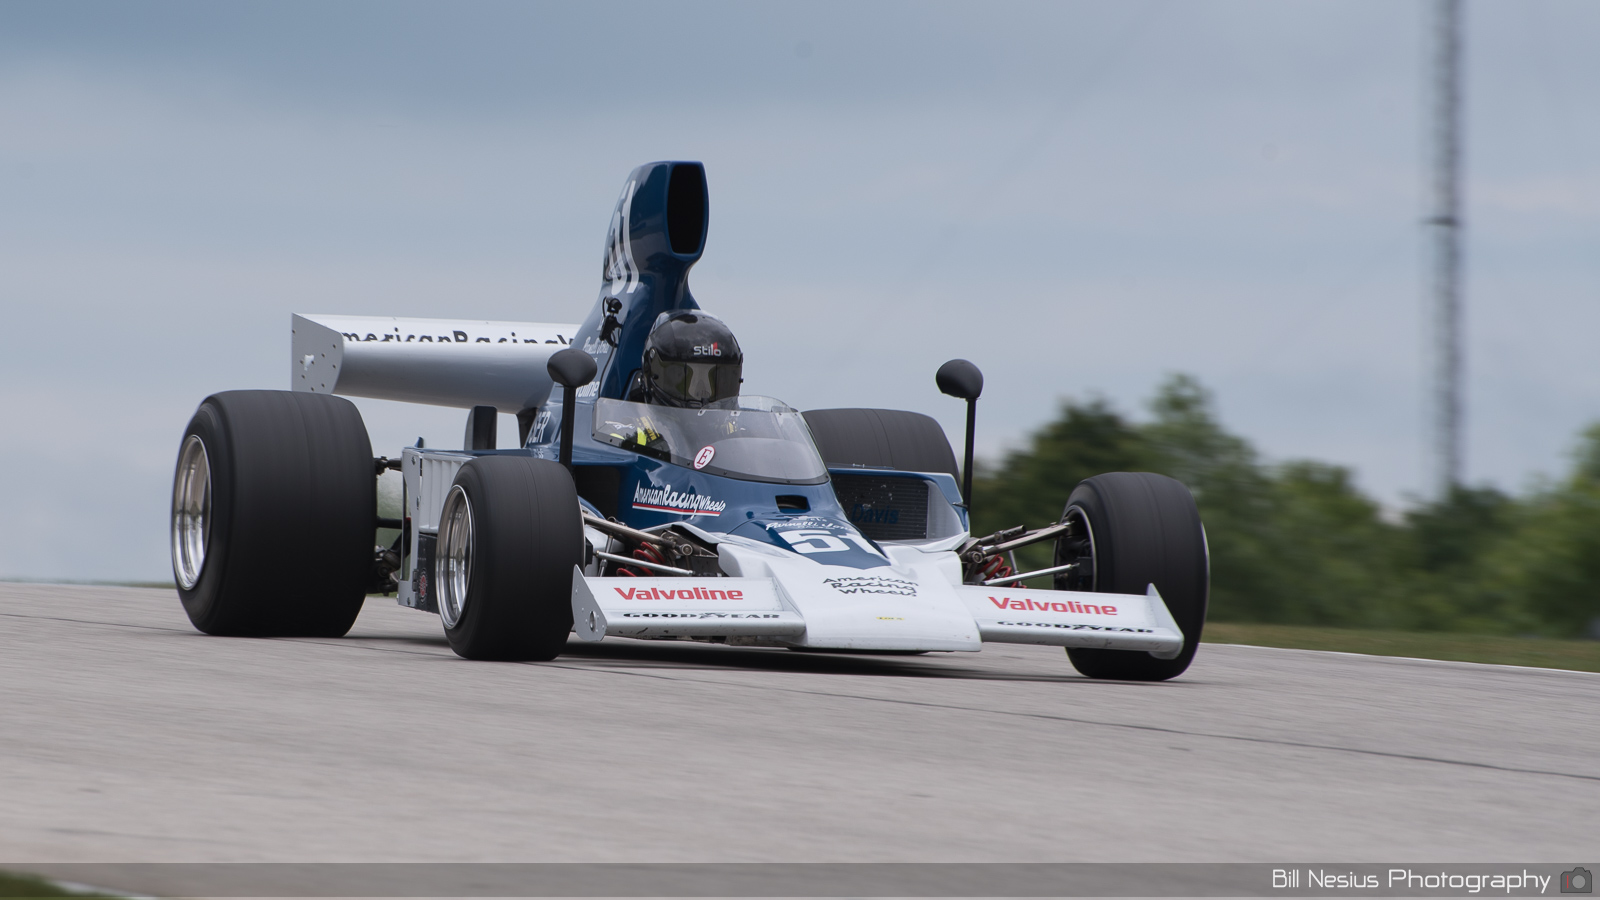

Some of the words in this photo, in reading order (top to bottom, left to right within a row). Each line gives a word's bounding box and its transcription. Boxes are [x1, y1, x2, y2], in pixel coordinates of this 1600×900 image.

[693, 342, 722, 357] Stilo
[851, 503, 900, 525] Davis
[779, 529, 885, 557] 51
[822, 576, 919, 587] American
[831, 581, 917, 594] Racing
[613, 587, 744, 601] Valvoline
[838, 587, 917, 597] Wheels
[988, 596, 1118, 616] Valvoline
[623, 612, 780, 620] GOODYEAR
[997, 620, 1154, 633] GOODYEAR
